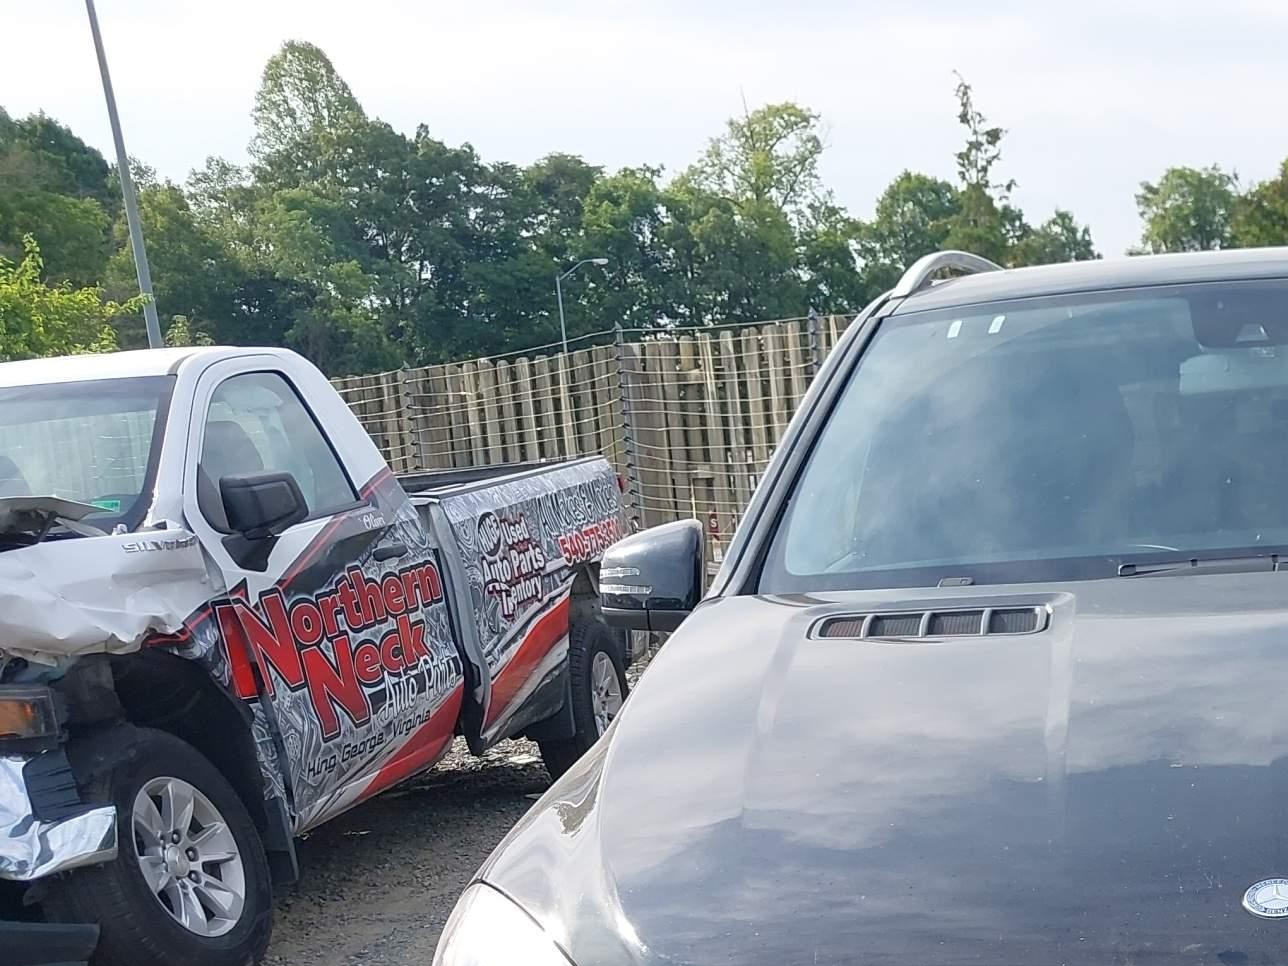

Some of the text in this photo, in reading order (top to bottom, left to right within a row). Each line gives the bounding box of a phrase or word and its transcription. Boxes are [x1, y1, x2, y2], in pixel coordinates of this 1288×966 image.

[478, 514, 500, 553] HUGE
[501, 516, 528, 545] Used
[482, 546, 545, 584] Auto Parts
[215, 561, 442, 699] Northern
[302, 617, 430, 741] Neck
[378, 656, 458, 722] Auto Parts
[307, 709, 431, 780] King George, Virginia
